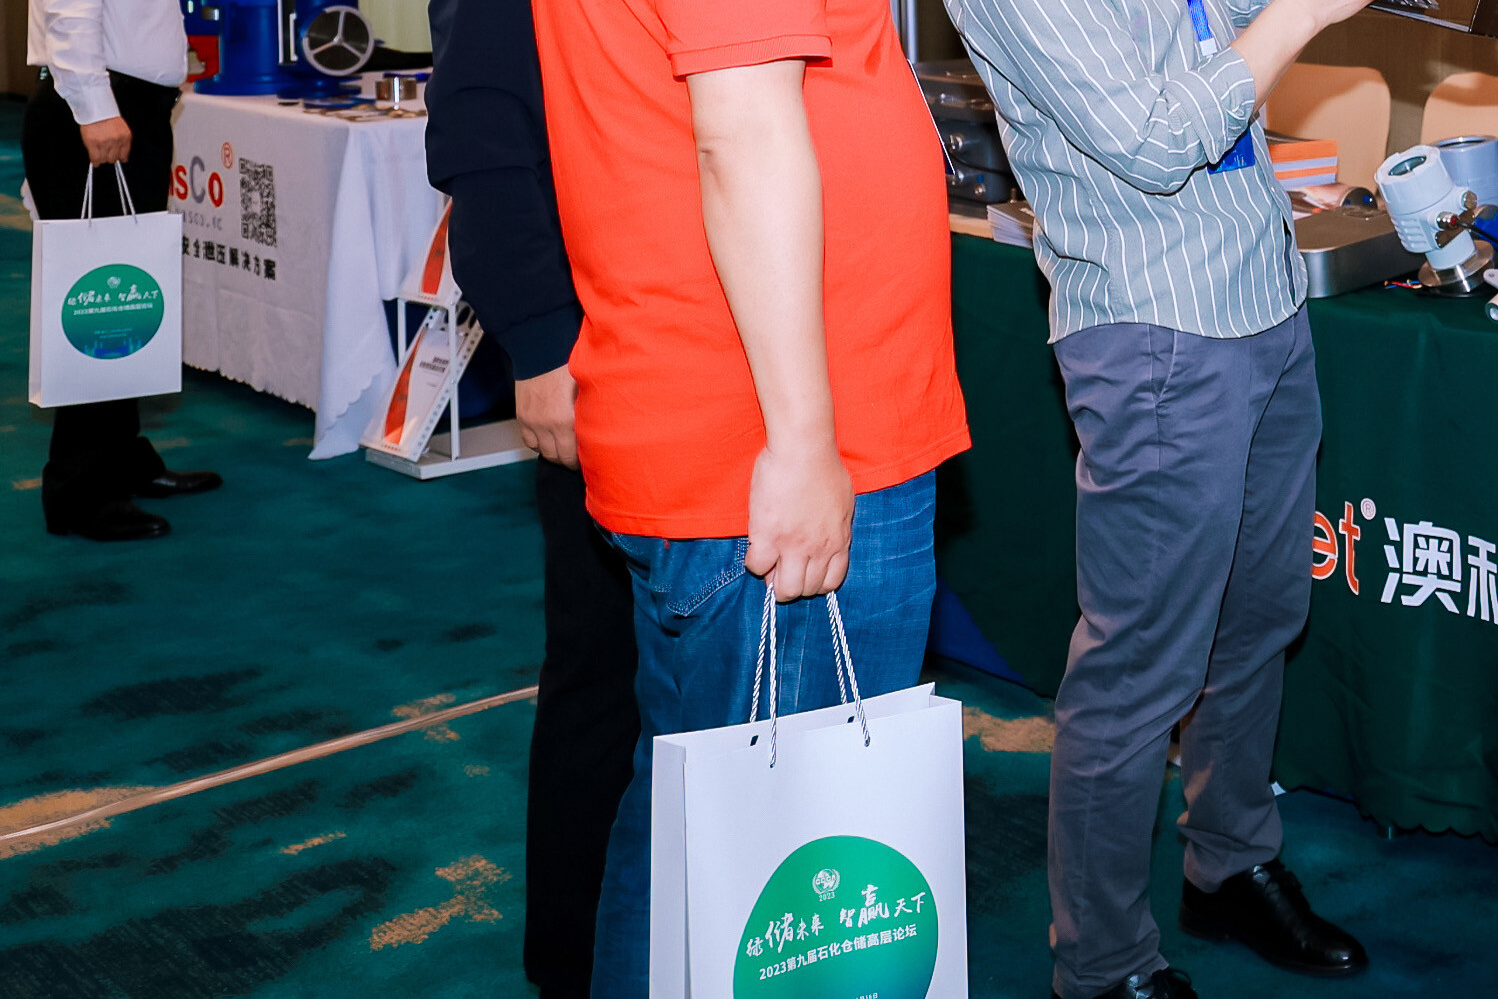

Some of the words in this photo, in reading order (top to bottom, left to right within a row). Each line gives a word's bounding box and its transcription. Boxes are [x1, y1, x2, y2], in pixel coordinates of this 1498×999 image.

[818, 891, 836, 902] 2023
[840, 884, 926, 928] 智赢天下
[759, 923, 918, 981] 2023第九届石化仓储高层论坛
